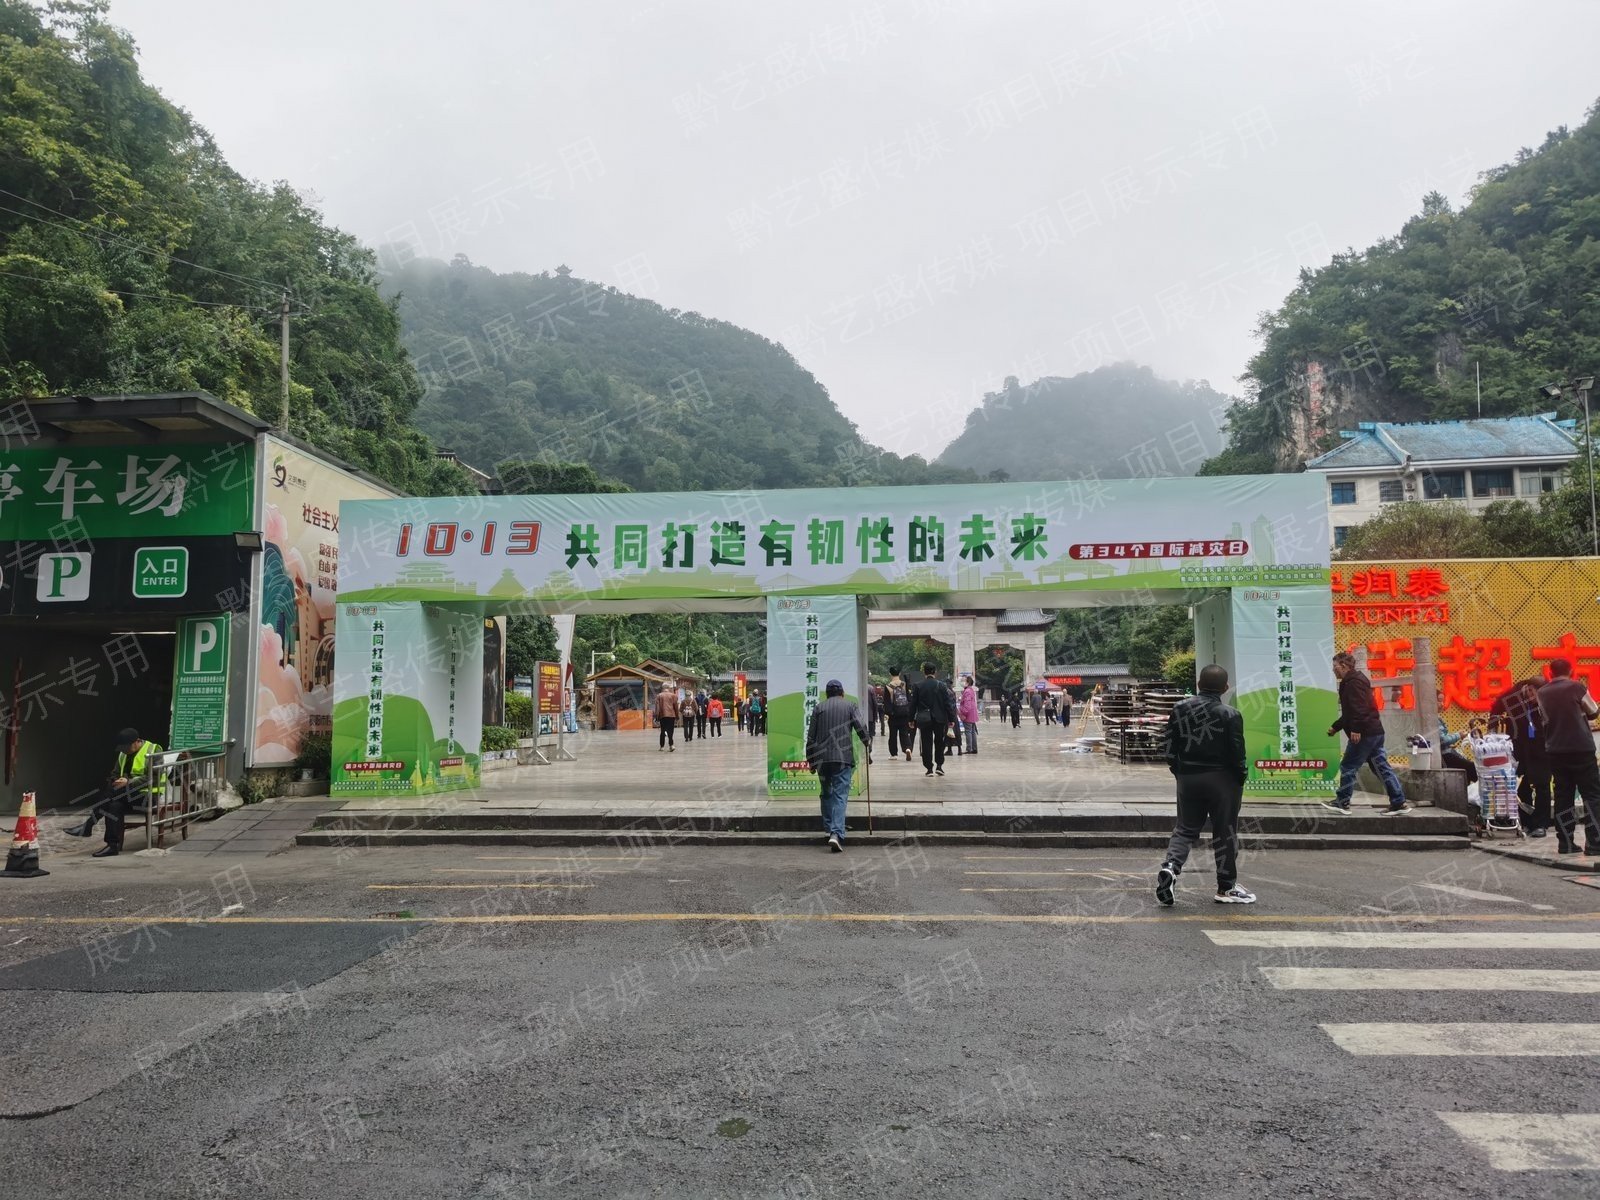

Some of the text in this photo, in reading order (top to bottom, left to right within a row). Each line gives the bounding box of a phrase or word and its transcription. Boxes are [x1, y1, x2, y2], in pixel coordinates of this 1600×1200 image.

[302, 502, 339, 533] 社会主义
[564, 511, 1049, 570] 共同打造有韧性的未来
[1079, 540, 1247, 559] 第34个国际减灾日
[142, 557, 178, 575] 入口
[142, 576, 178, 587] ENTER
[193, 622, 217, 671] P
[367, 620, 385, 757] 共同打造有韧性的未来
[1276, 606, 1296, 753] 共同打造有韧性的未来
